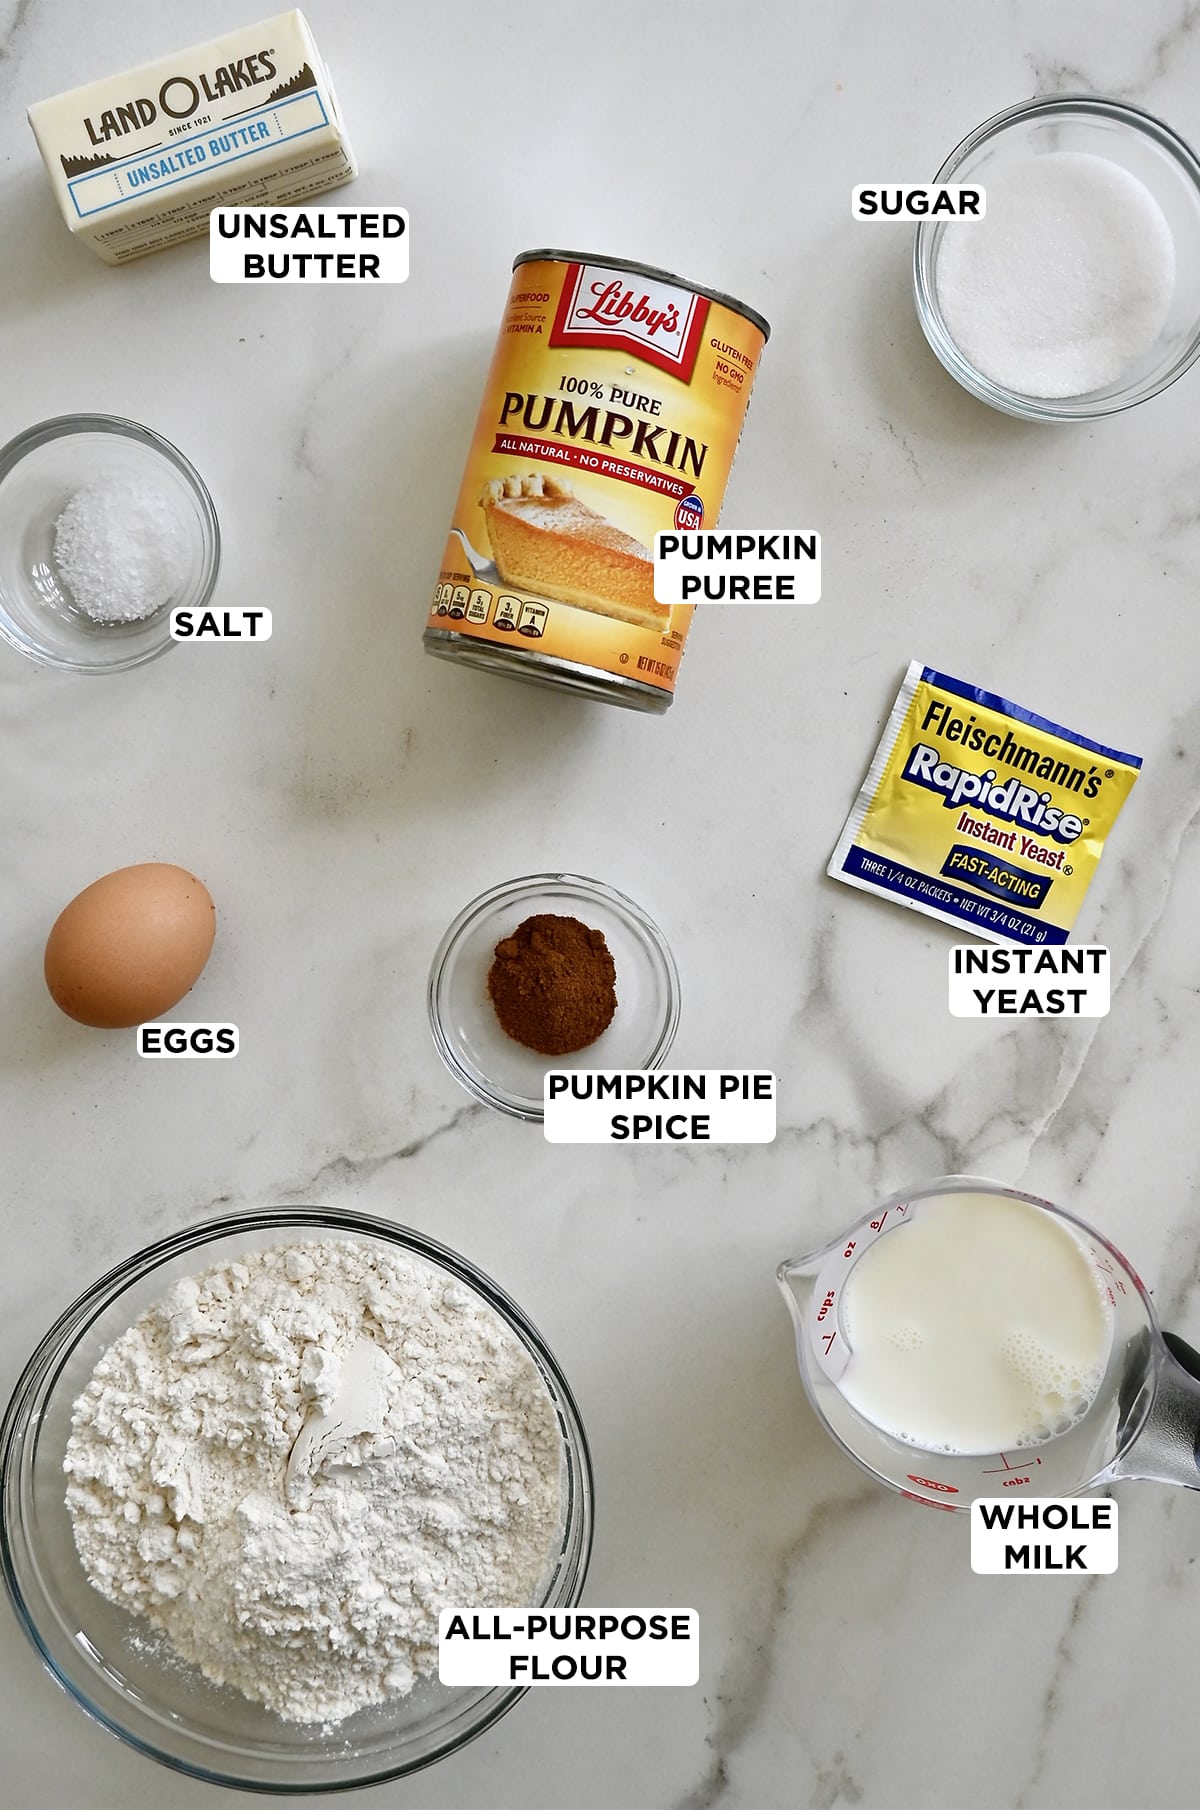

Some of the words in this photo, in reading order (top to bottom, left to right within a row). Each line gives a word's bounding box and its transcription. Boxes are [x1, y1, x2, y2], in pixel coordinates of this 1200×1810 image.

[83, 98, 157, 146] LAND
[159, 76, 200, 119] O
[199, 50, 277, 102] LAKES
[168, 122, 192, 137] SINCE
[193, 115, 212, 127] 1921
[127, 145, 206, 188] UNSALTED
[208, 121, 271, 157] BUTTER
[535, 325, 543, 334] A
[576, 280, 680, 336] Libby's
[711, 338, 742, 362] GLUTEN
[716, 361, 729, 374] NO
[730, 369, 744, 384] GMO
[559, 375, 604, 400] 100%
[609, 386, 662, 416] PURE
[498, 392, 709, 479] PUMPKIN
[500, 439, 517, 450] ALL
[519, 441, 570, 461] NATURAL
[579, 454, 599, 467] NO
[601, 461, 684, 496] PRESERVATIVES
[678, 509, 701, 530] USA
[637, 656, 649, 671] NET
[921, 700, 1102, 798] Fleischmann's
[906, 743, 1084, 841] RapidRise
[956, 811, 1017, 852] Instant
[1019, 835, 1065, 871] Yeast
[949, 852, 1041, 899] FAST-ACTING
[861, 857, 888, 877] THREE
[887, 868, 905, 884] 1/4
[904, 876, 918, 889] OZ
[917, 881, 953, 903] PACKETS
[960, 898, 978, 913] NET
[976, 904, 992, 918] WT
[990, 910, 1008, 926] 3/4
[1007, 917, 1022, 931] OZ
[1020, 922, 1036, 937] (21
[1035, 930, 1048, 943] g)
[844, 1241, 857, 1258] oz
[816, 1290, 835, 1322] cups
[916, 1477, 949, 1491] OXO
